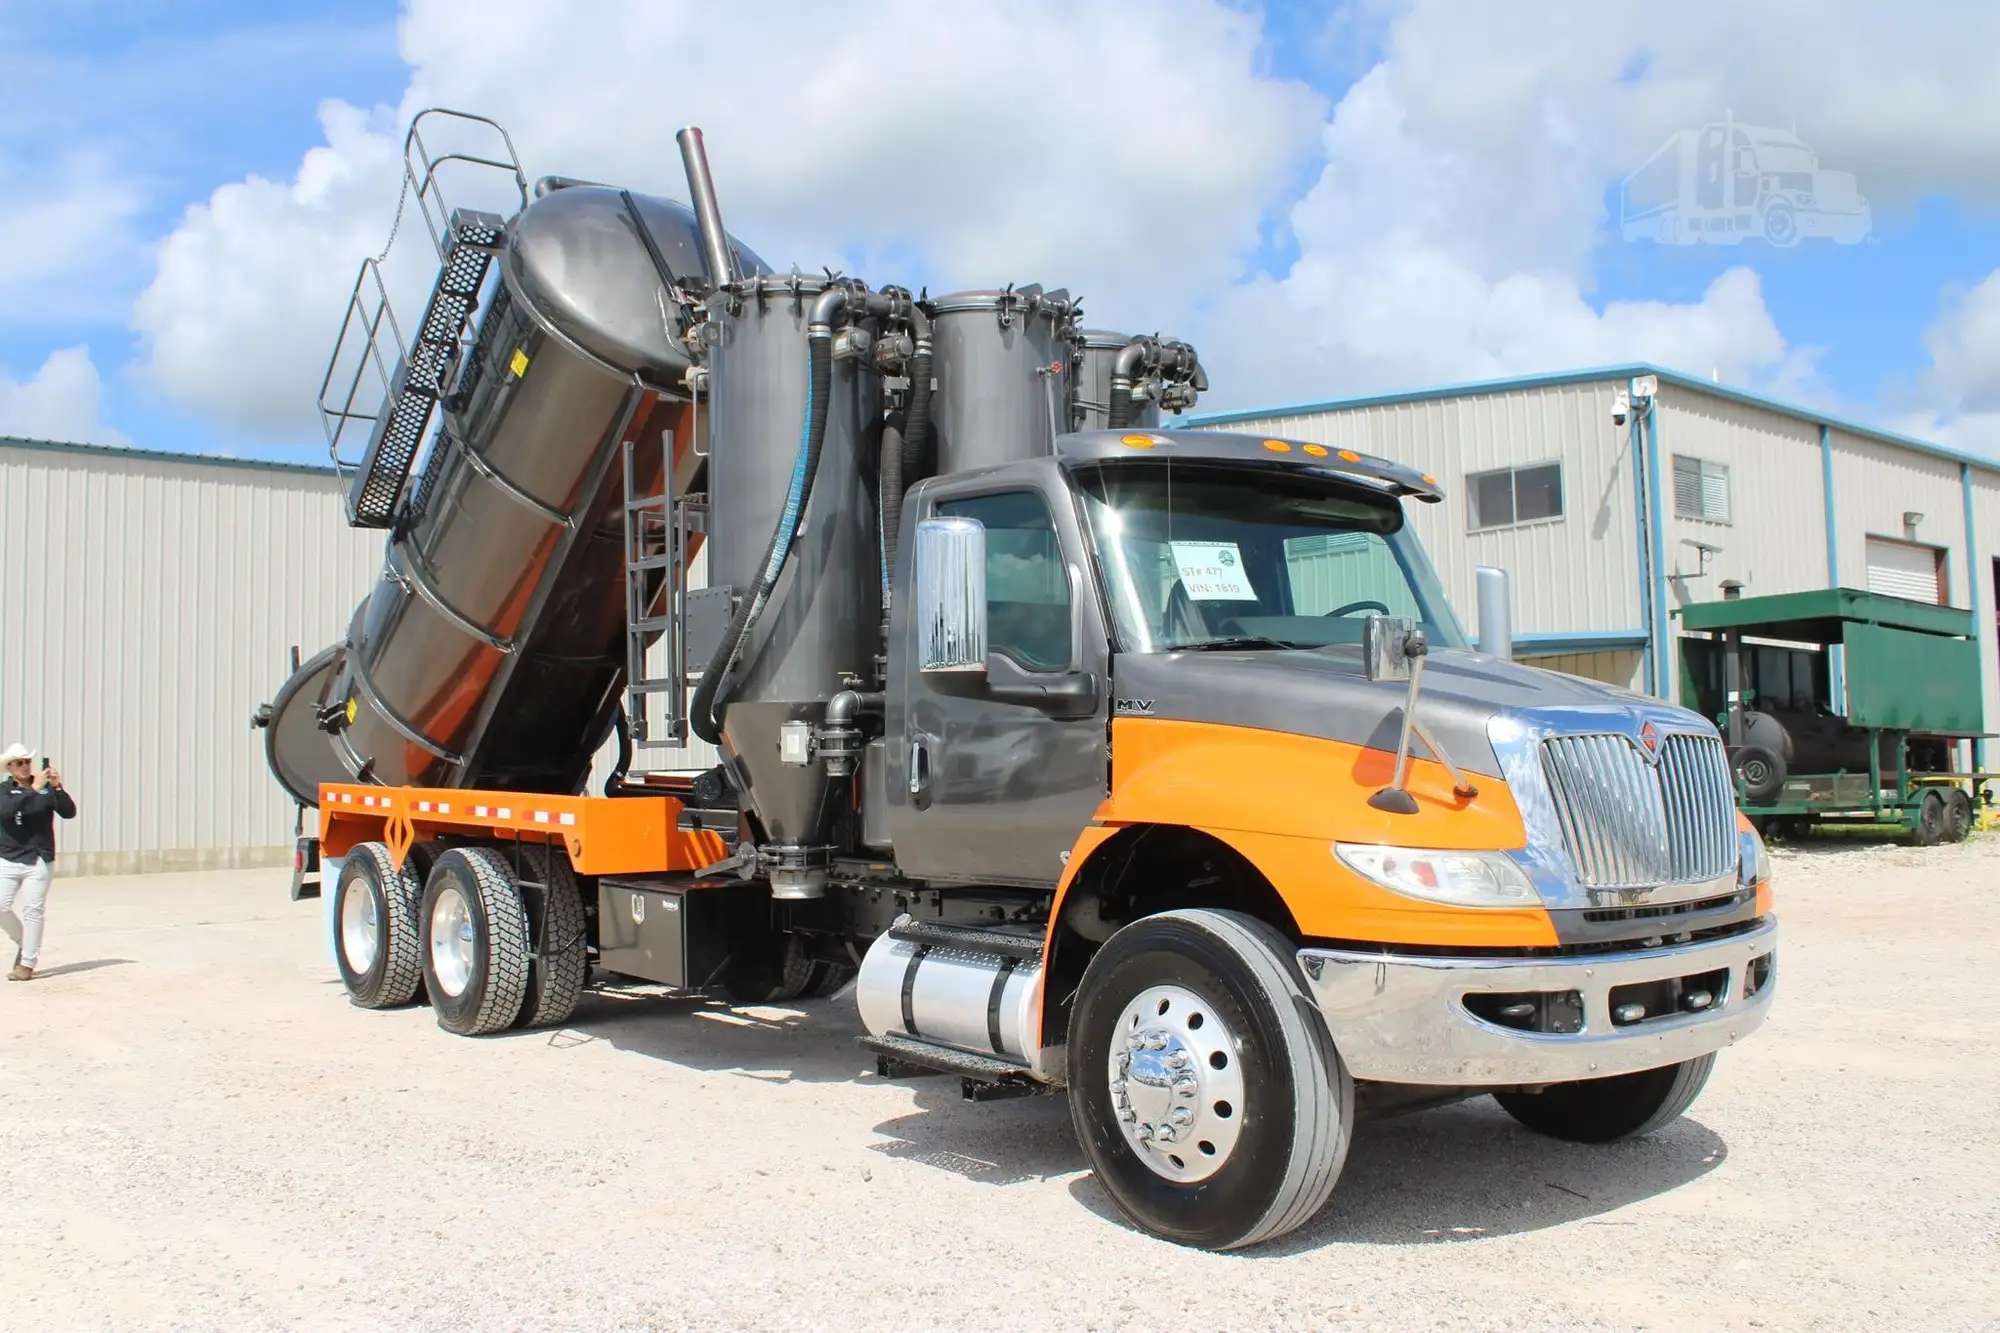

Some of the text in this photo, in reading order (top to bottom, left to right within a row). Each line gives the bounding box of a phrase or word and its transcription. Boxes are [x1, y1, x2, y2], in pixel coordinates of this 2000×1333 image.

[1181, 566, 1223, 578] ST# 477
[1187, 584, 1213, 593] VIN:
[1116, 699, 1155, 711] MV
